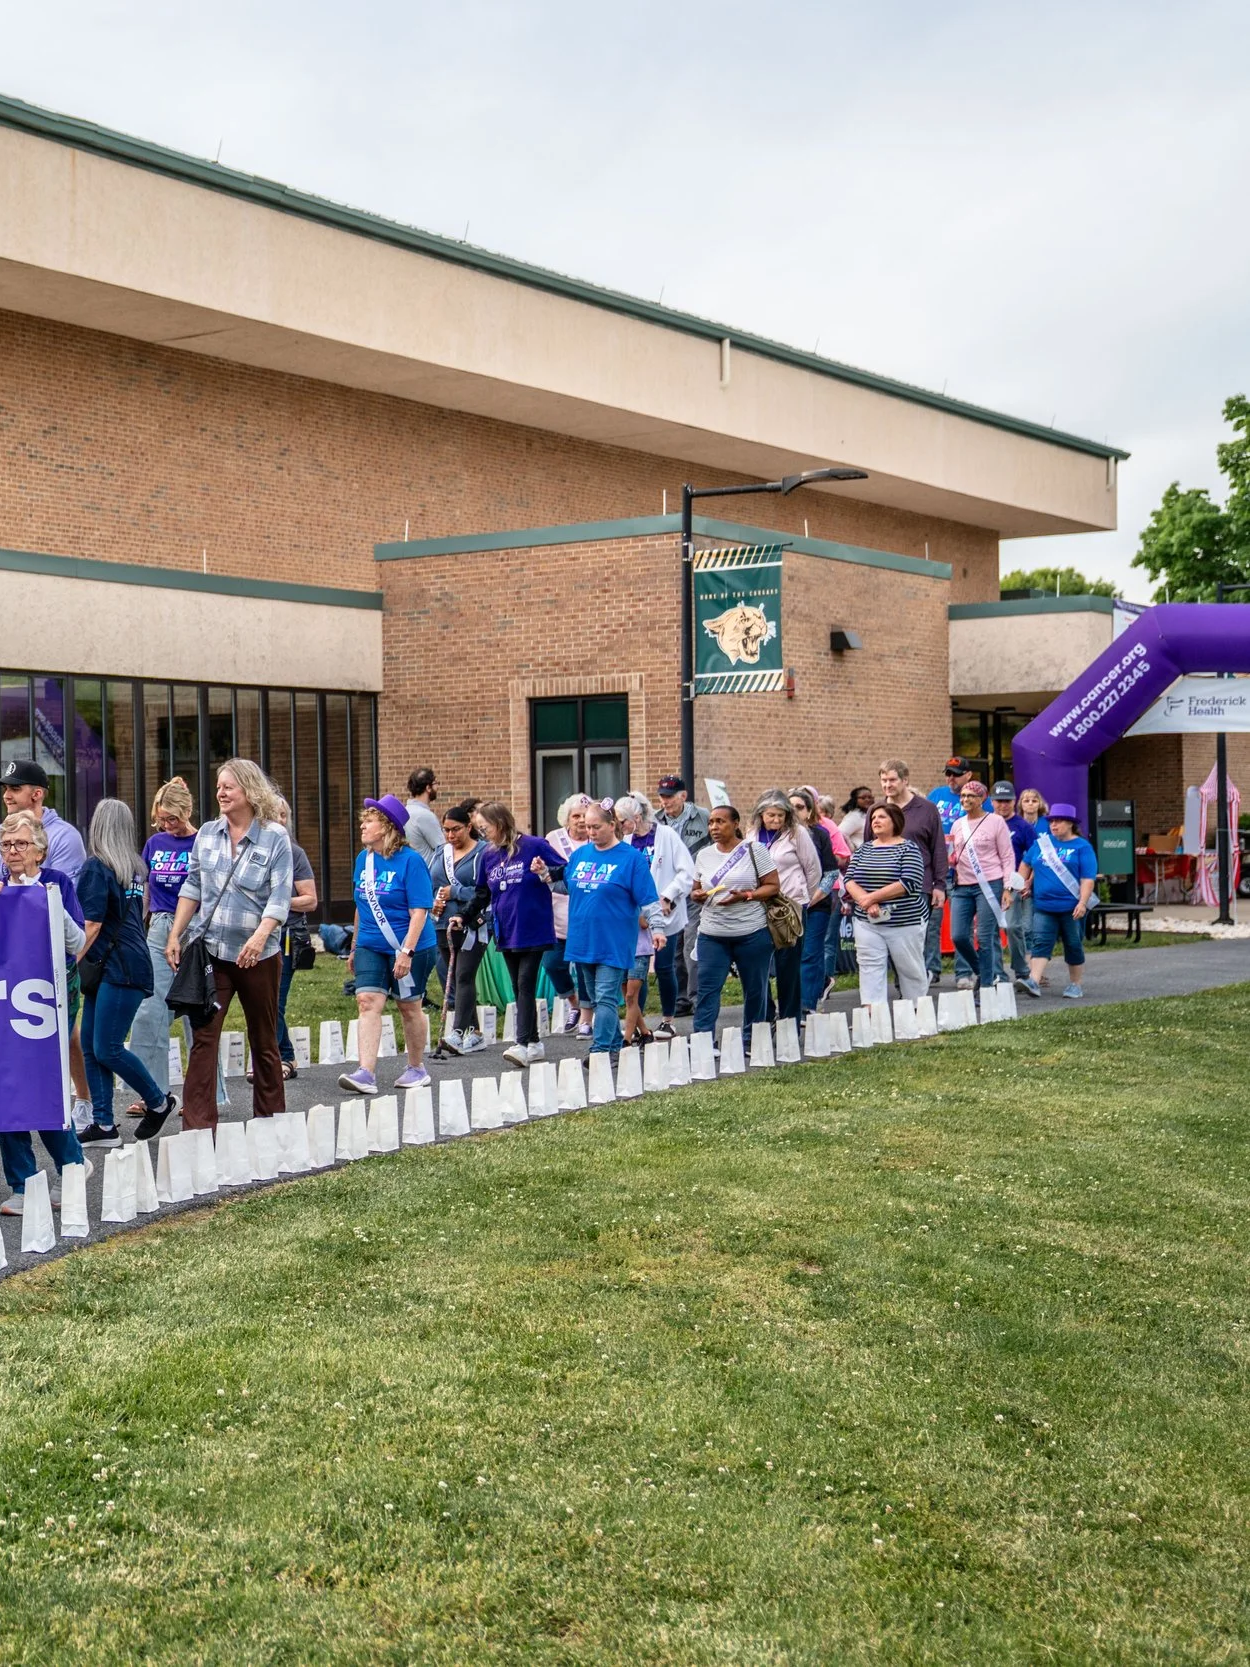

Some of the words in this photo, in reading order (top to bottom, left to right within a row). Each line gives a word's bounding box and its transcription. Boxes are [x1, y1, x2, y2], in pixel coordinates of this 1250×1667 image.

[1049, 642, 1147, 738] www.cancer.org
[1067, 660, 1150, 742] 1.800.227.2345
[1188, 695, 1247, 706] Frederick
[1188, 706, 1225, 716] Health
[685, 829, 703, 838] ARMY
[575, 861, 618, 875] RELAY
[366, 880, 386, 926] SURVIVOR
